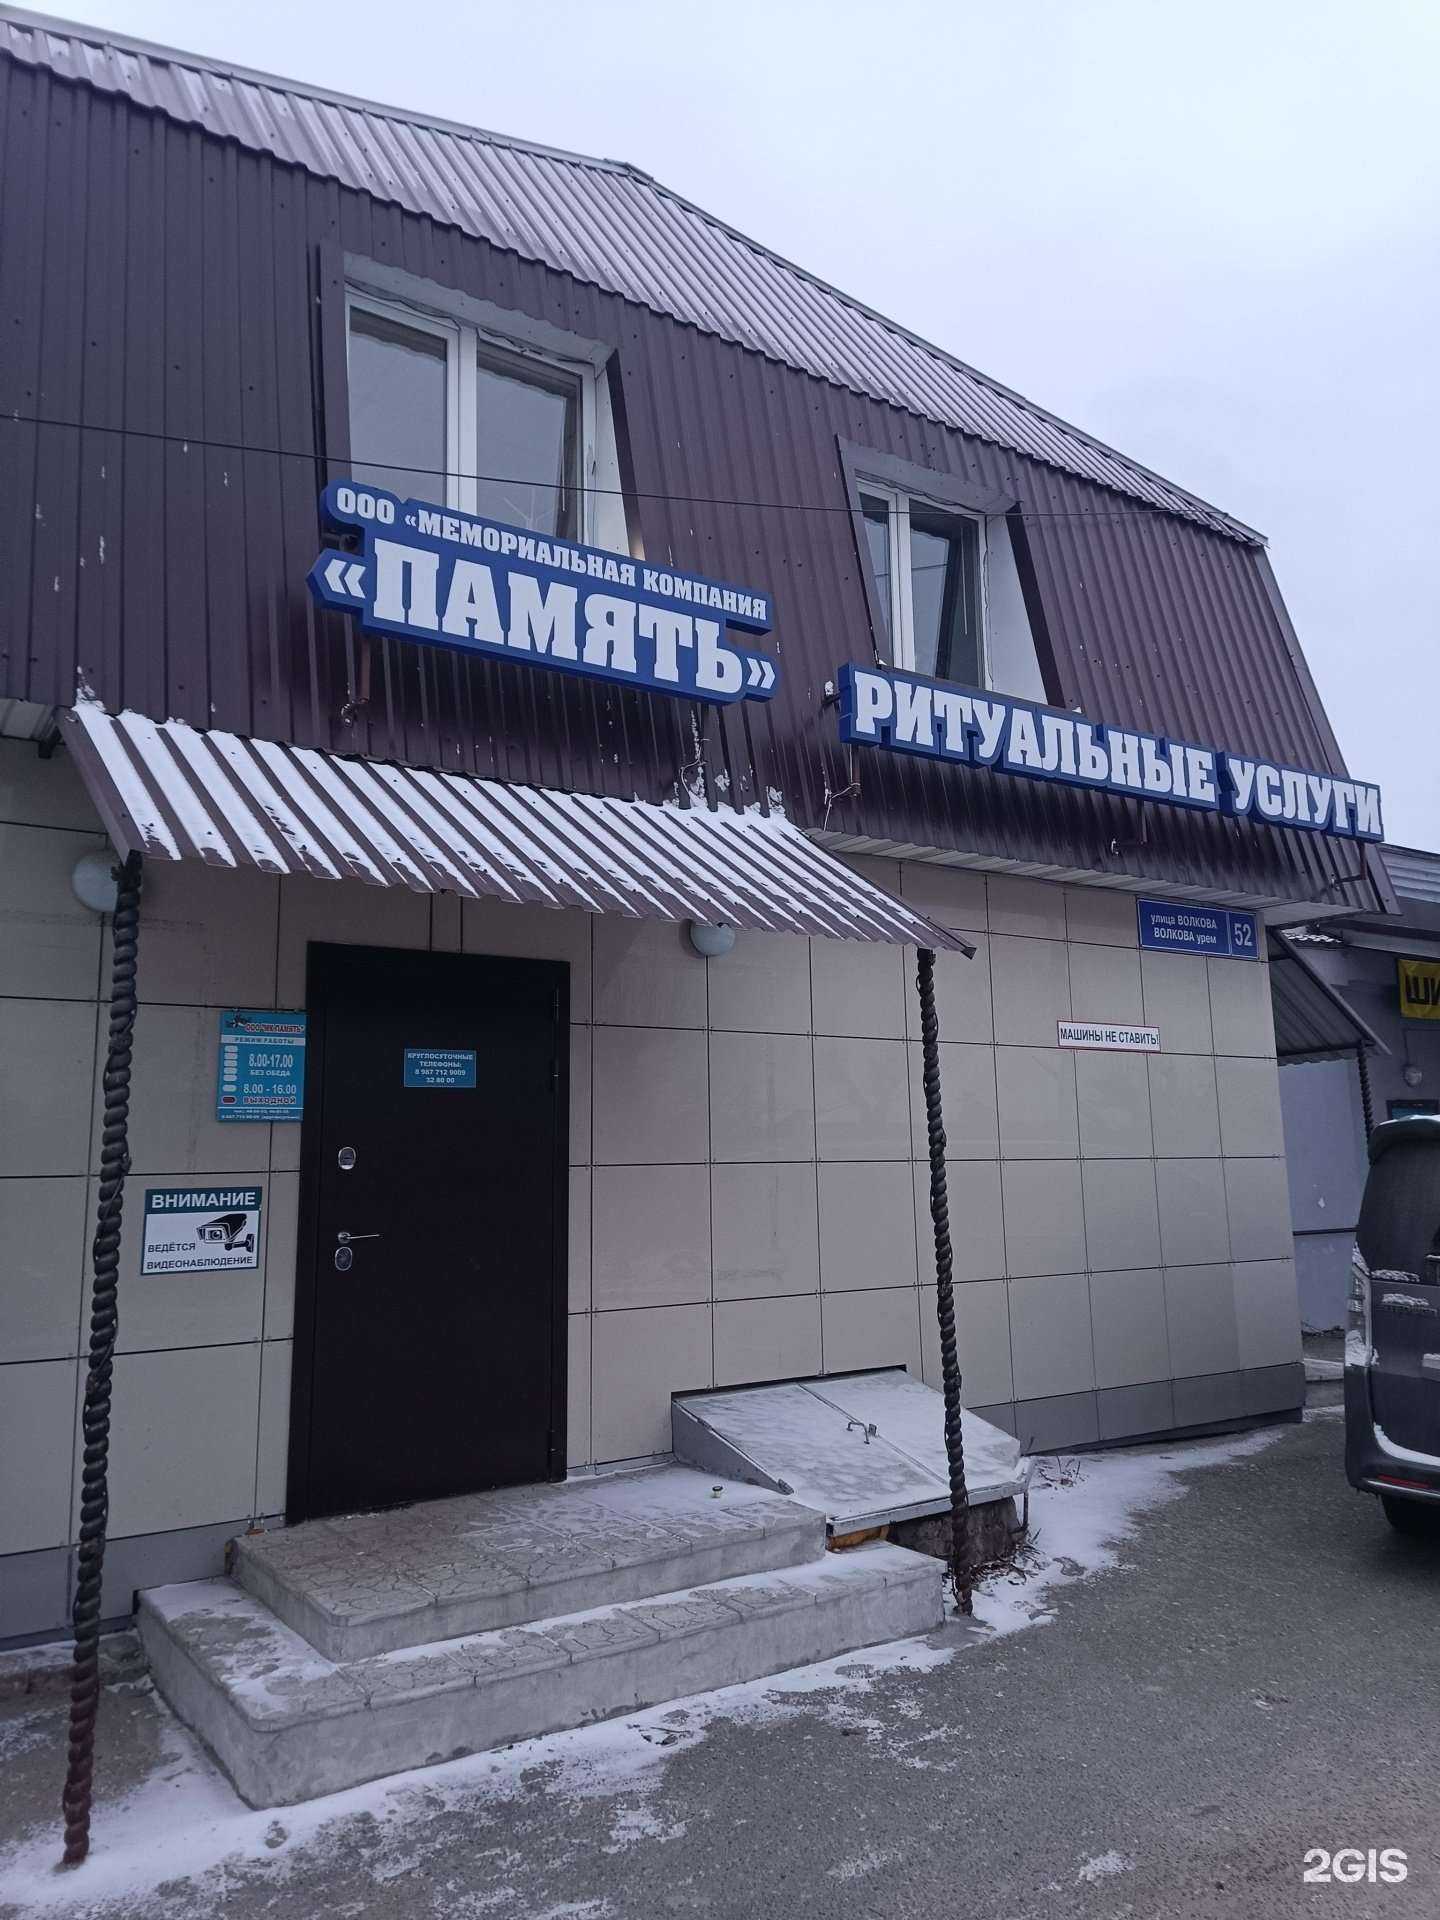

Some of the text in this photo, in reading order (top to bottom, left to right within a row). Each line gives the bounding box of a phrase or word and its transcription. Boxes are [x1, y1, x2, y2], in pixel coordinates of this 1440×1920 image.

[336, 486, 768, 621] ООО «МЕМОРИАЛЬНАЯ КОМПАНИЯ
[323, 537, 777, 694] «ПАМЯТЬ»
[854, 670, 1384, 837] РИТУАЛЬНЫЕ УСЛУГИ
[1150, 914, 1217, 929] улица ВОЛКОВА
[1154, 927, 1217, 945] ВОЛКОВА урем
[1233, 923, 1253, 946] 52
[1060, 1028, 1160, 1045] МАШИНЫ НЕ СТАВИТЬ!
[243, 1083, 264, 1094] 8.00
[272, 1083, 297, 1095] 16.00
[151, 1191, 256, 1209] ВНИМАНИЕ
[147, 1242, 196, 1254] ВЕДЁТСЯ
[146, 1256, 253, 1270] ВИДЕОНАБЛЮДЕНИЕ
